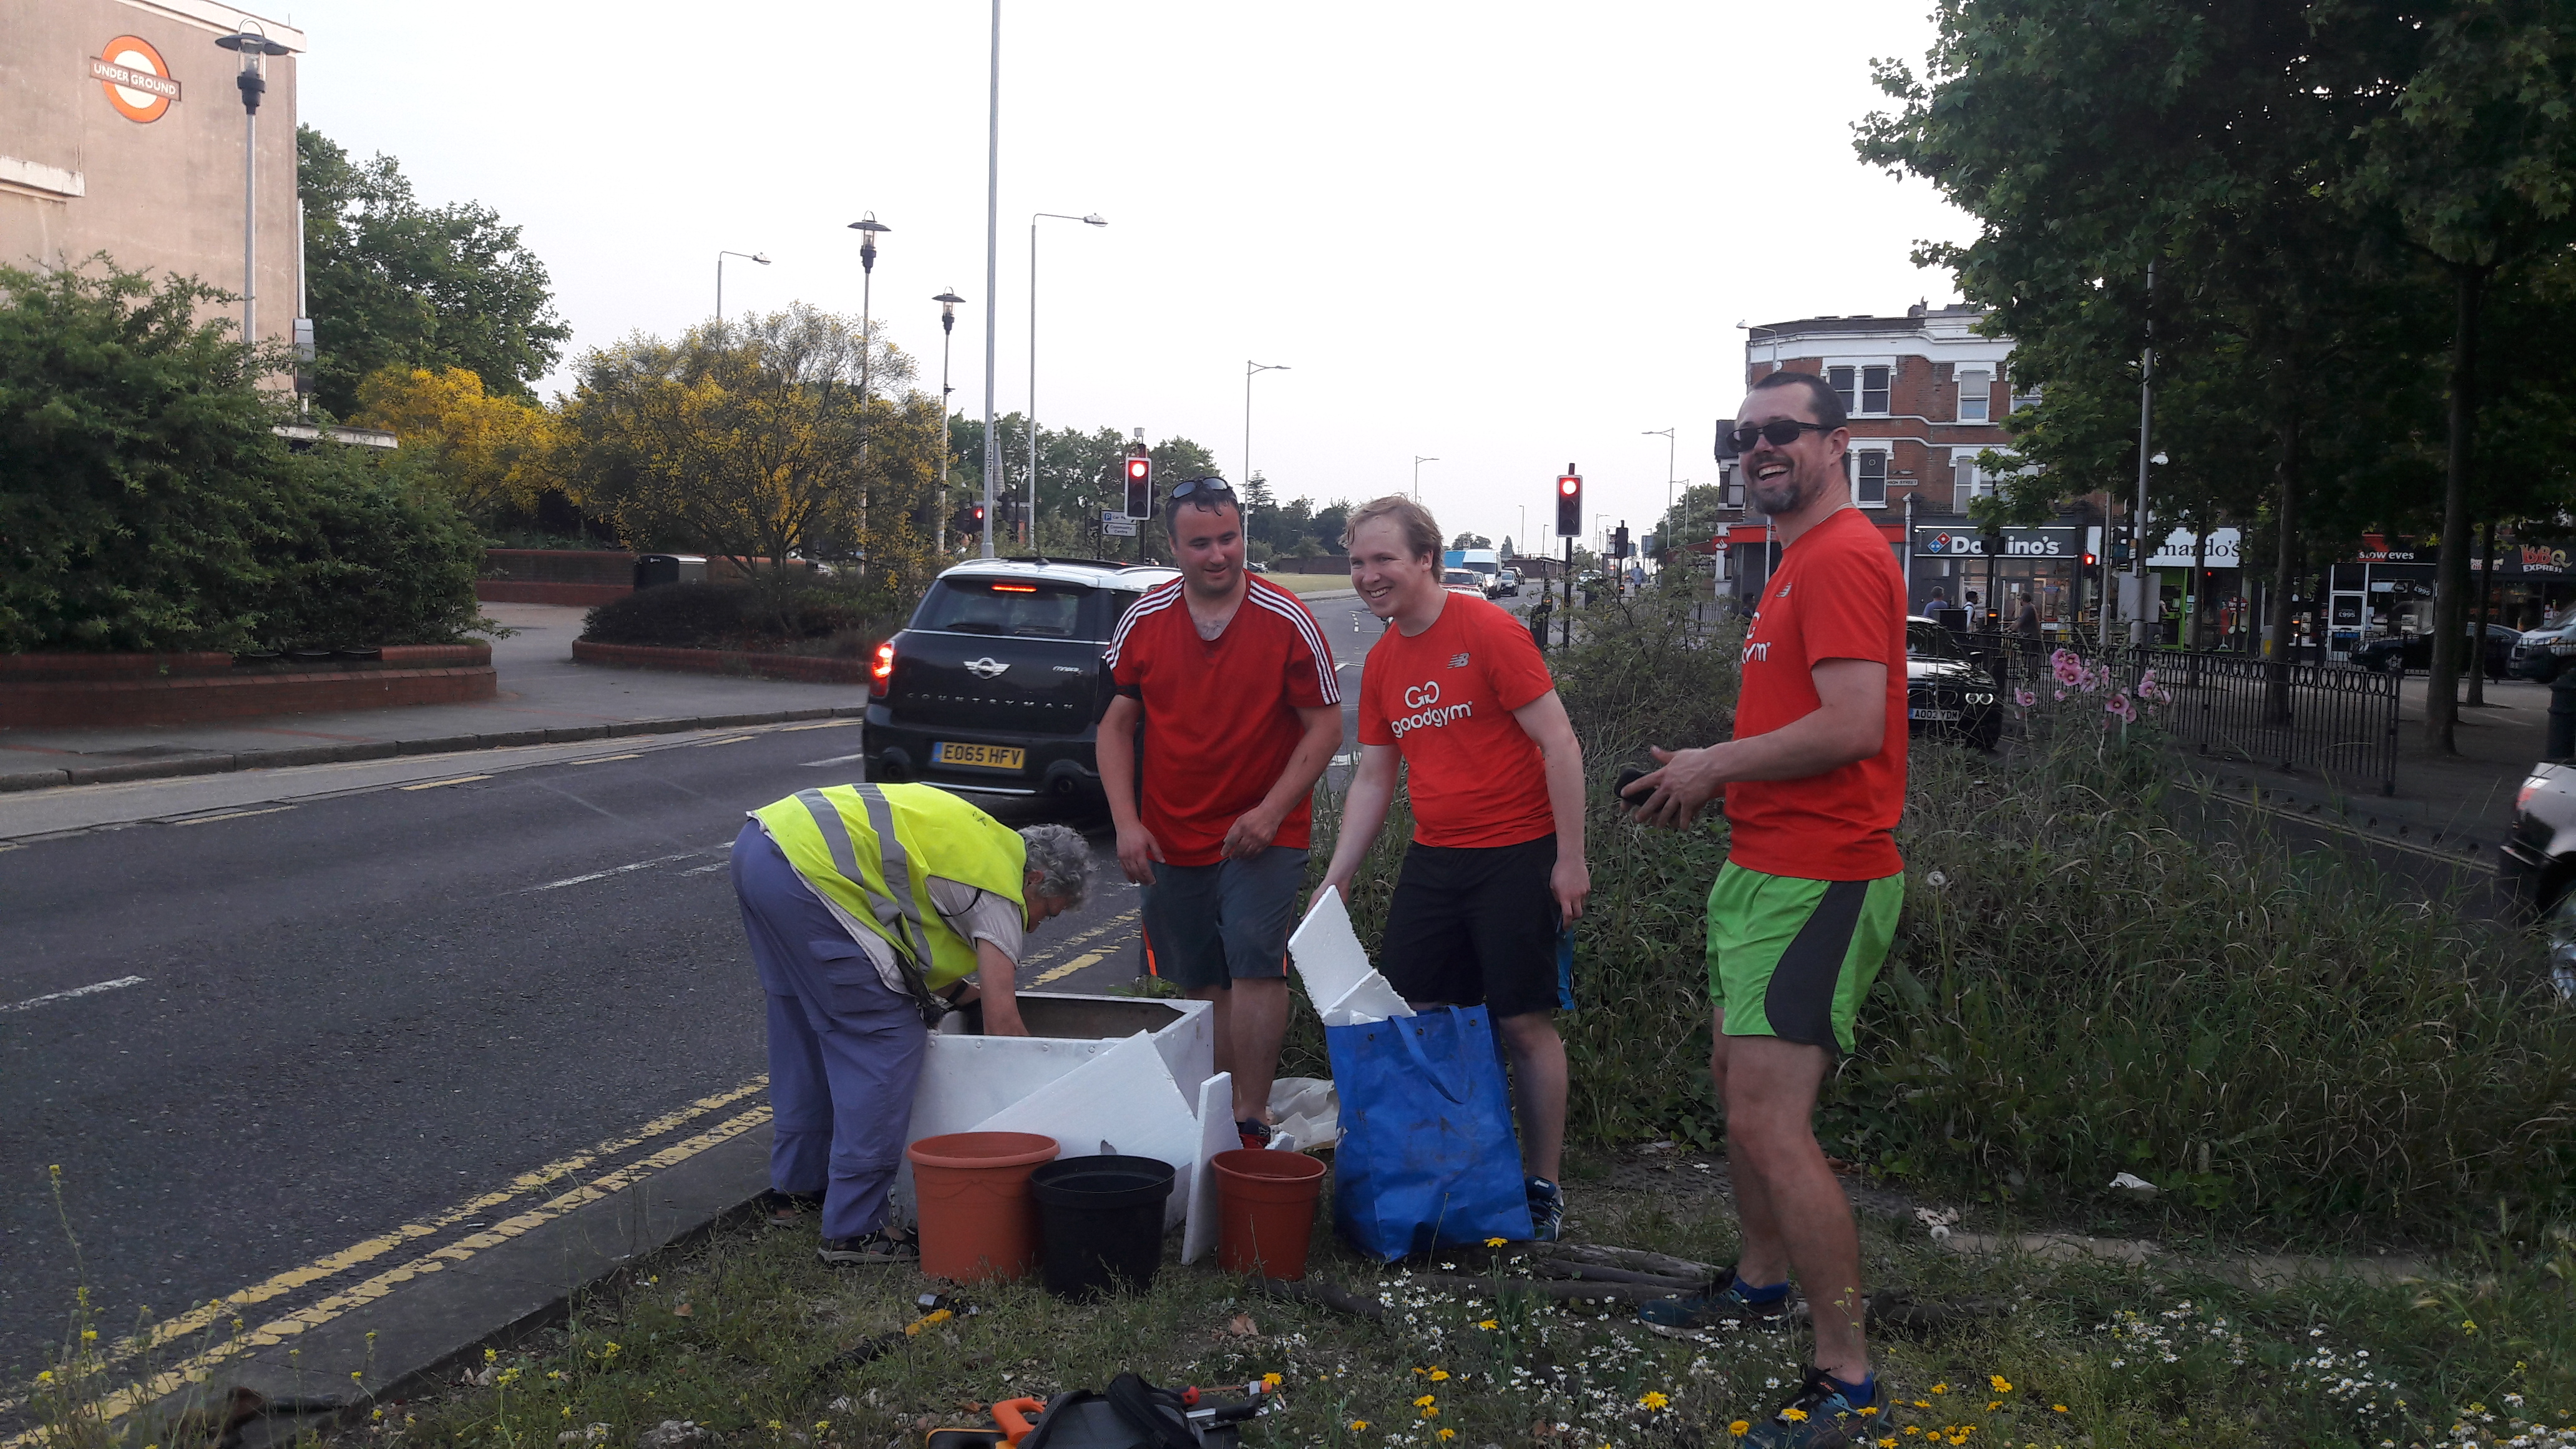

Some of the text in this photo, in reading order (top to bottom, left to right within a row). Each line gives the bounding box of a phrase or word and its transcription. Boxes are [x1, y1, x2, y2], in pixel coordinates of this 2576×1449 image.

[1951, 535, 2060, 555] Doino's
[2388, 552, 2414, 560] eves
[2519, 544, 2574, 568] BBQ
[2522, 564, 2563, 573] EXPRESS
[2414, 585, 2432, 596] £995
[1391, 701, 1473, 739] goodgym
[988, 748, 1022, 766] HFV
